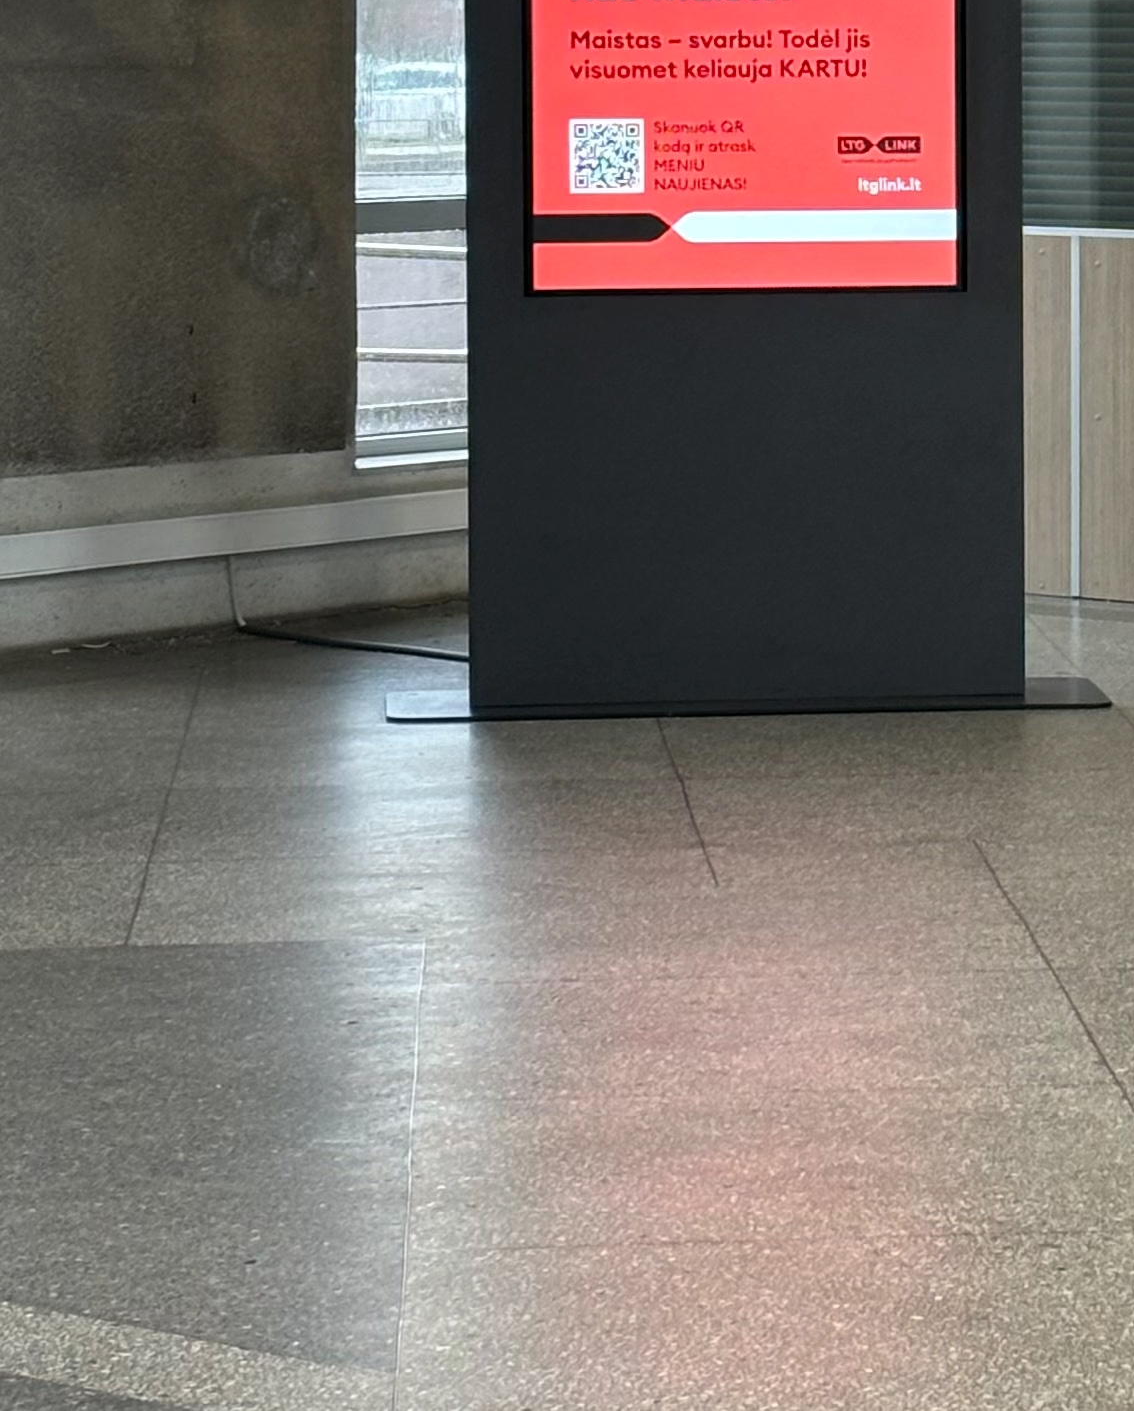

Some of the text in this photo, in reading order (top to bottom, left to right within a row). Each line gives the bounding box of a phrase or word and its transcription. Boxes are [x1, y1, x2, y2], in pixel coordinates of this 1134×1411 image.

[570, 30, 662, 50] Maistas
[688, 28, 773, 50] svarbu!
[778, 28, 840, 50] Todėl
[845, 28, 871, 54] jis
[569, 58, 868, 84] visuomet keliauja KARTU!
[720, 119, 745, 134] QR
[708, 138, 757, 153] atrask
[840, 139, 917, 151] LTG LINK
[653, 158, 705, 172] MENIU
[653, 177, 748, 191] NAUJIENAS!
[857, 176, 922, 195] ltglink.lt
